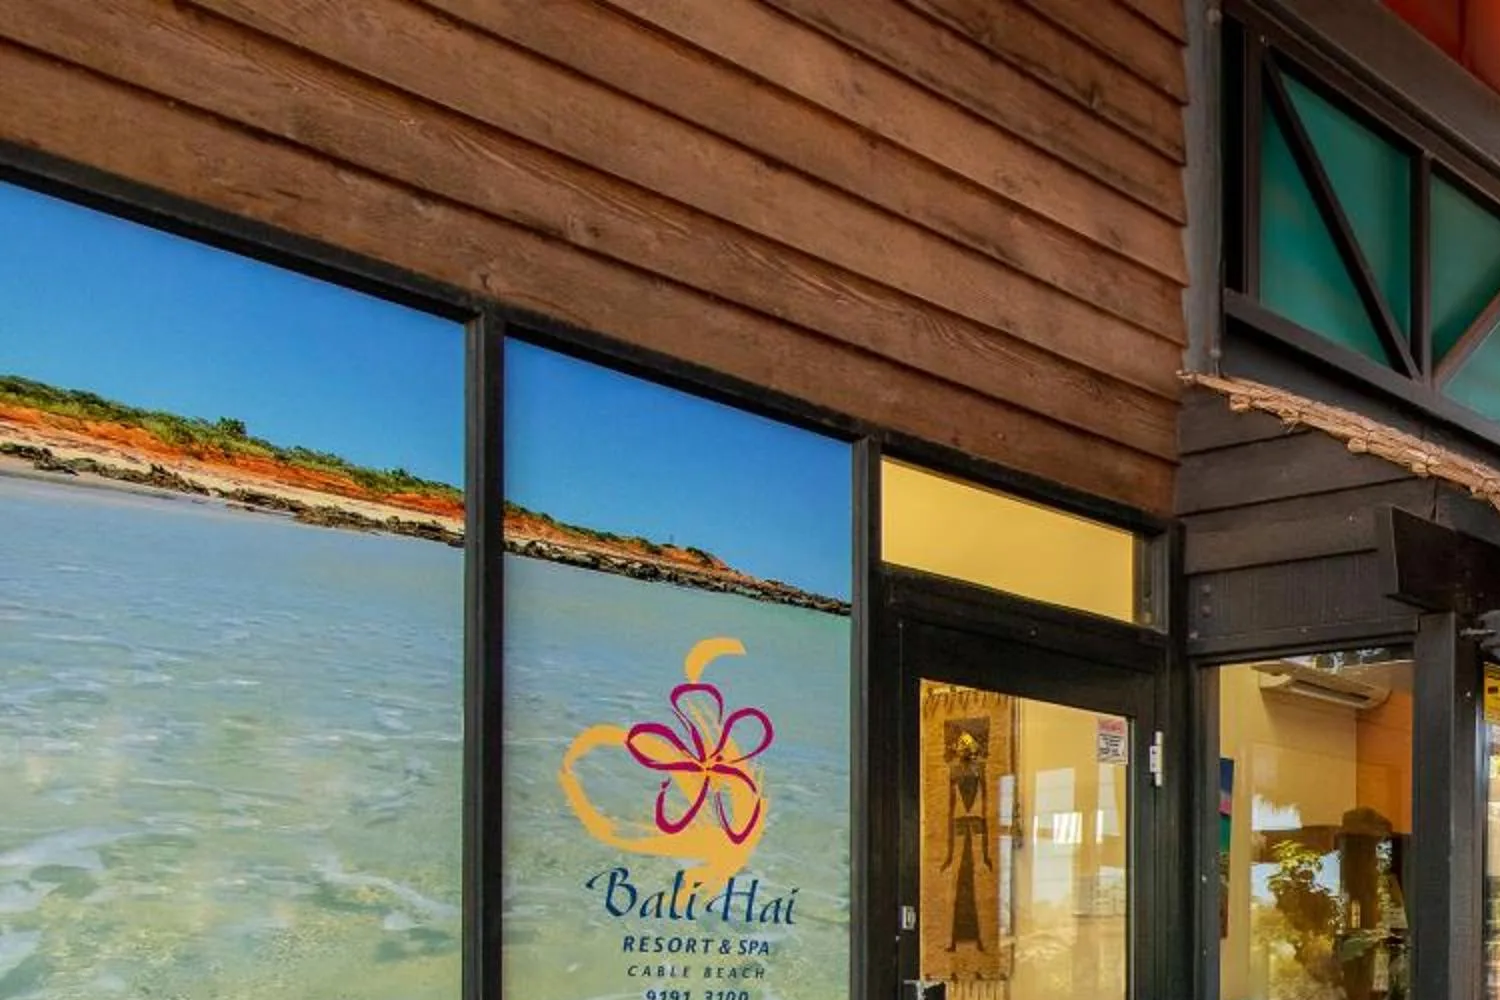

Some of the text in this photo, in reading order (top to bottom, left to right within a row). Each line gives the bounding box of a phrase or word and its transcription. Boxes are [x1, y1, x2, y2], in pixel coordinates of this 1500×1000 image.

[586, 867, 799, 924] Bali Hai
[623, 935, 769, 956] RESORT & SPA
[627, 965, 765, 980] CABLE BEACH
